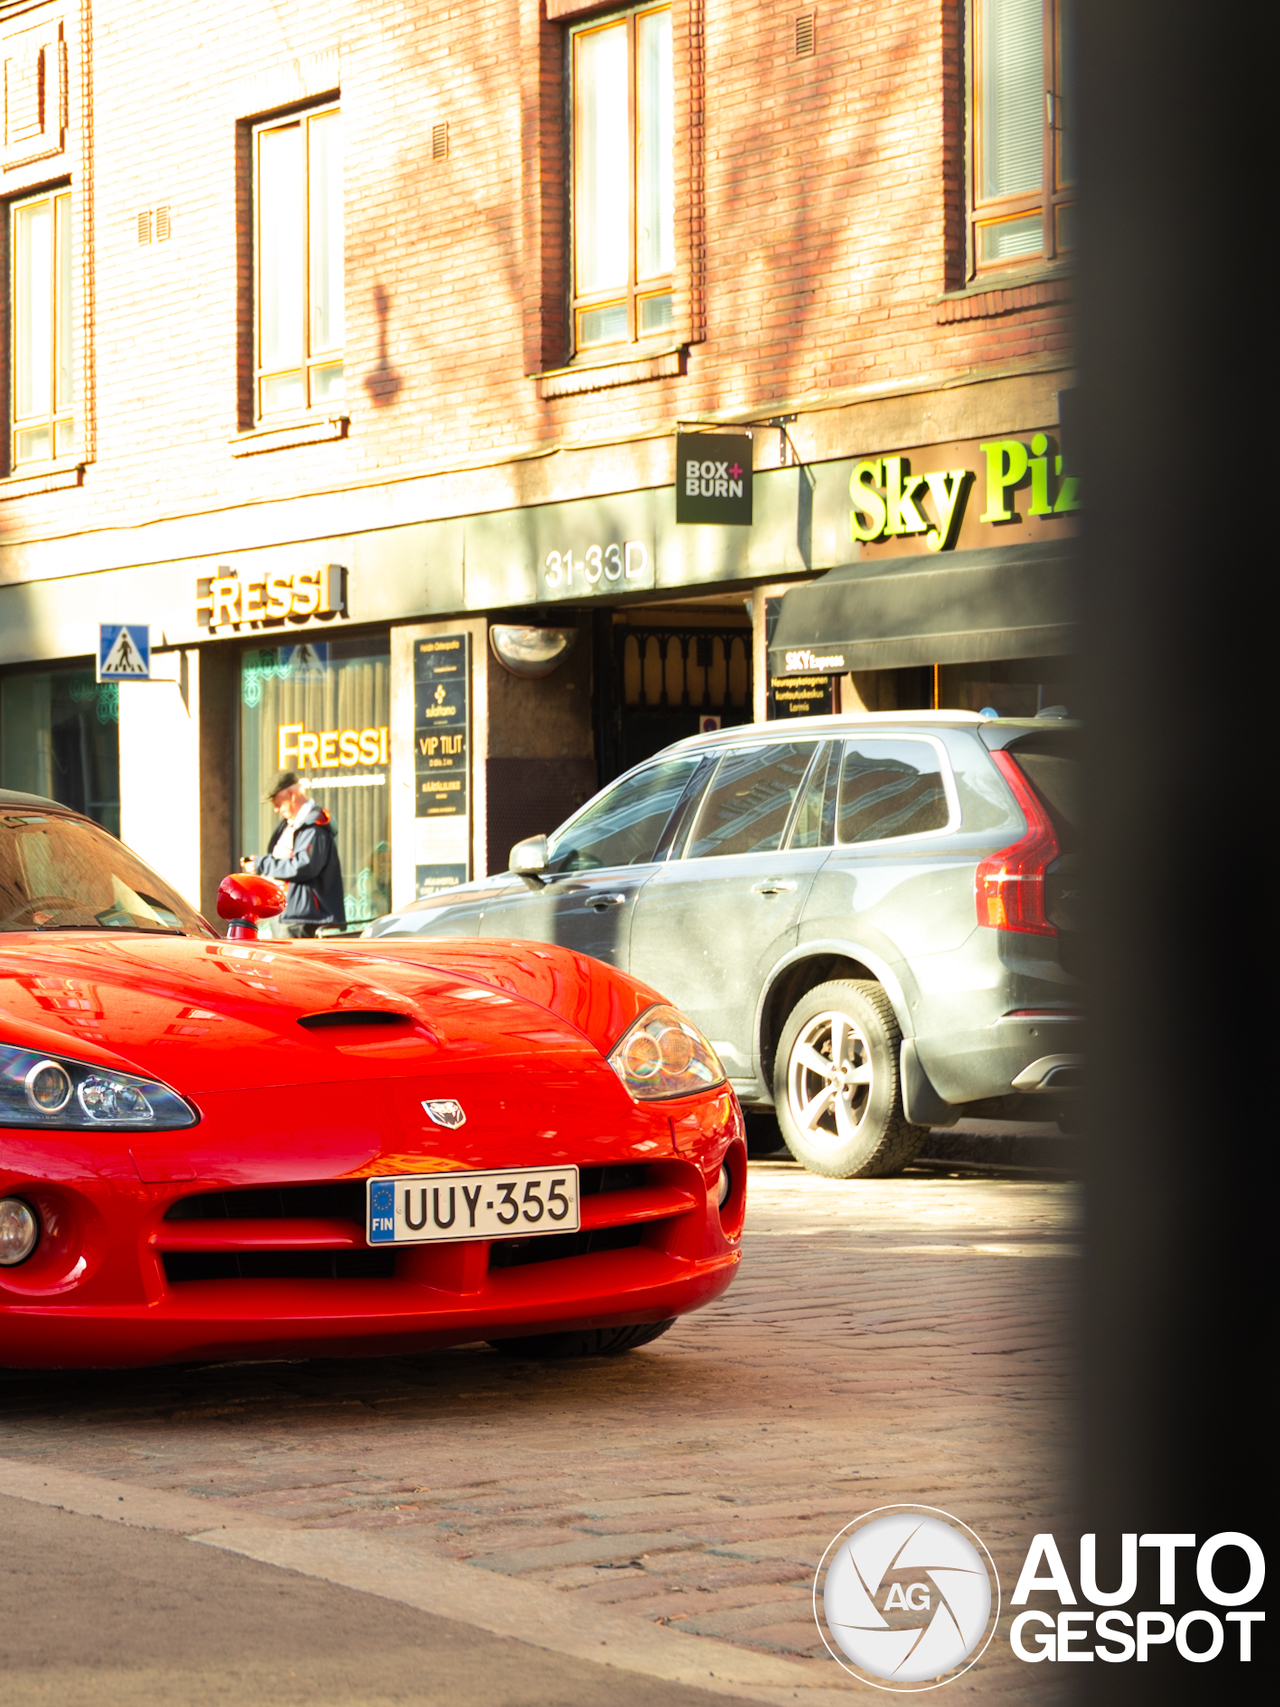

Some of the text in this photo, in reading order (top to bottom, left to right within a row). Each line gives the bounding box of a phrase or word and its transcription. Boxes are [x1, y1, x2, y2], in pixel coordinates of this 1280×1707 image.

[686, 479, 743, 498] BURN
[849, 455, 966, 551] Sky
[278, 721, 389, 771] FRESSI
[419, 736, 439, 755] VIP
[405, 1179, 569, 1231] UUY-355
[372, 1217, 393, 1231] FIN
